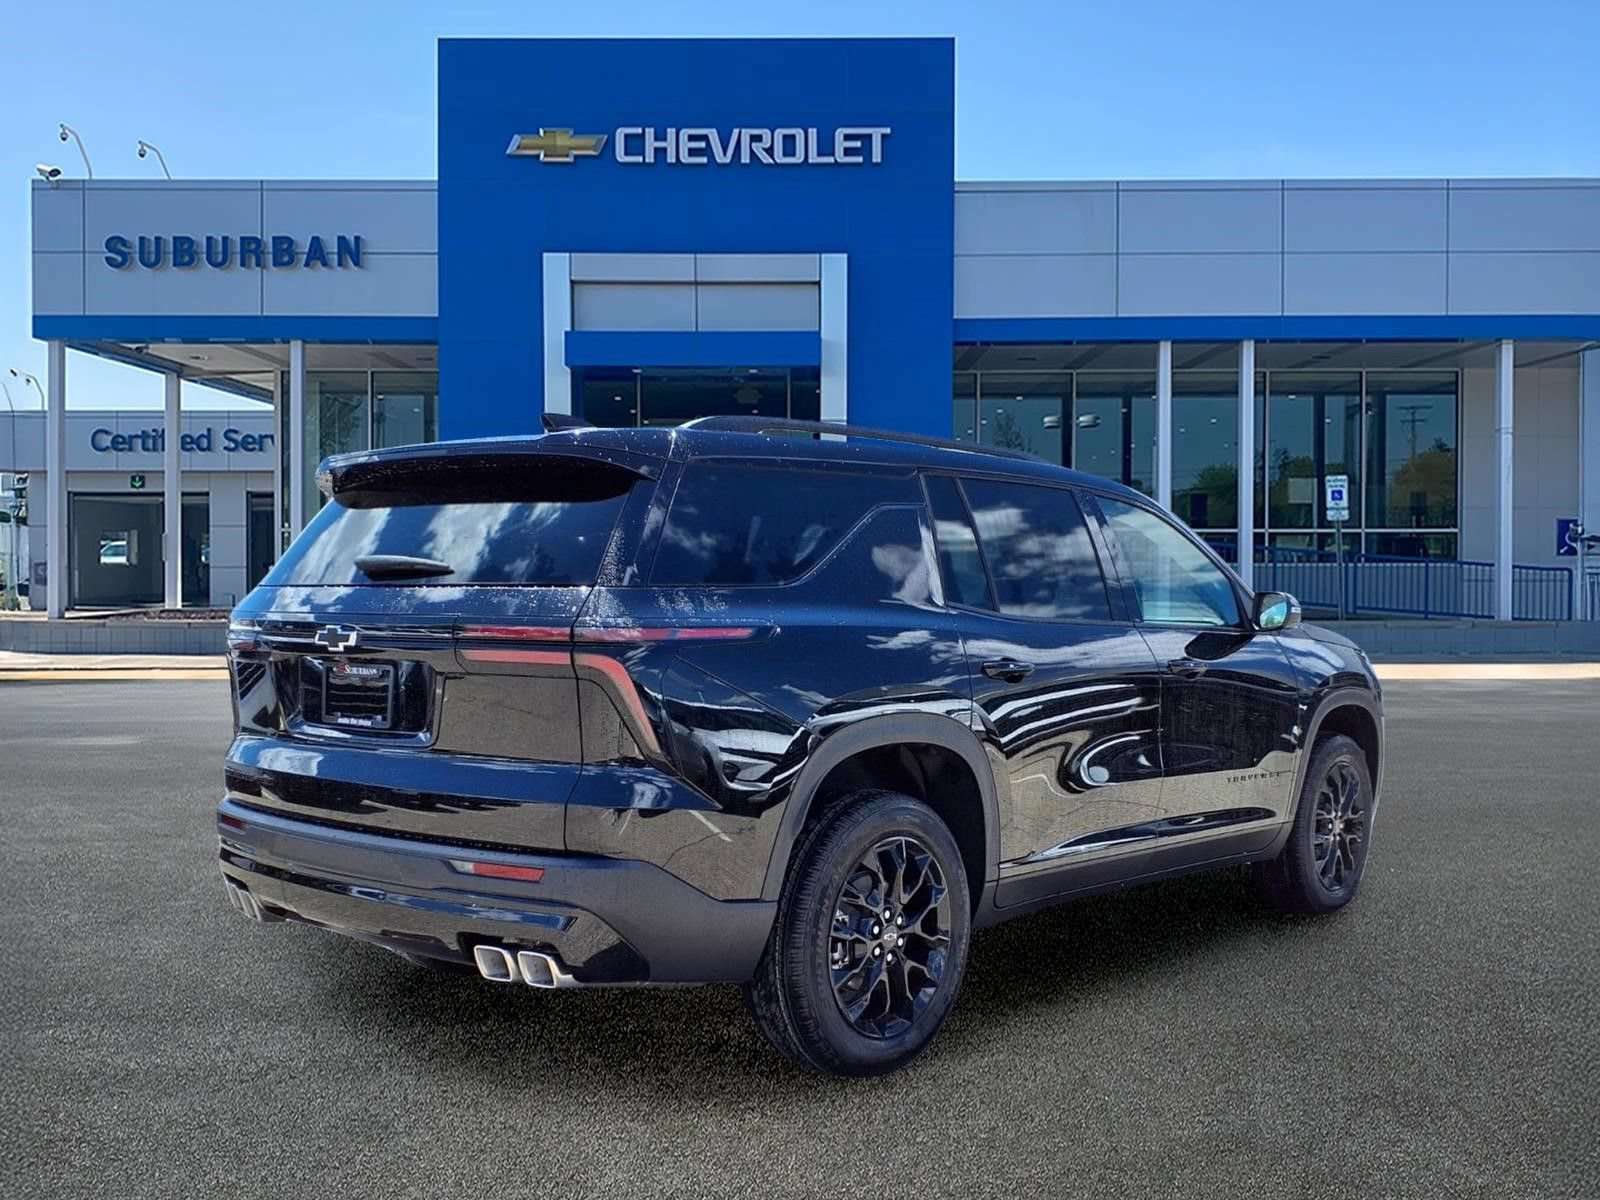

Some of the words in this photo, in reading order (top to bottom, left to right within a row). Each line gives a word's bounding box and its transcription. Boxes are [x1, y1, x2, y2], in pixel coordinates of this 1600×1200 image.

[615, 127, 891, 164] CHEVROLET
[104, 235, 364, 269] SUBURBAN
[91, 428, 213, 452] Certifed
